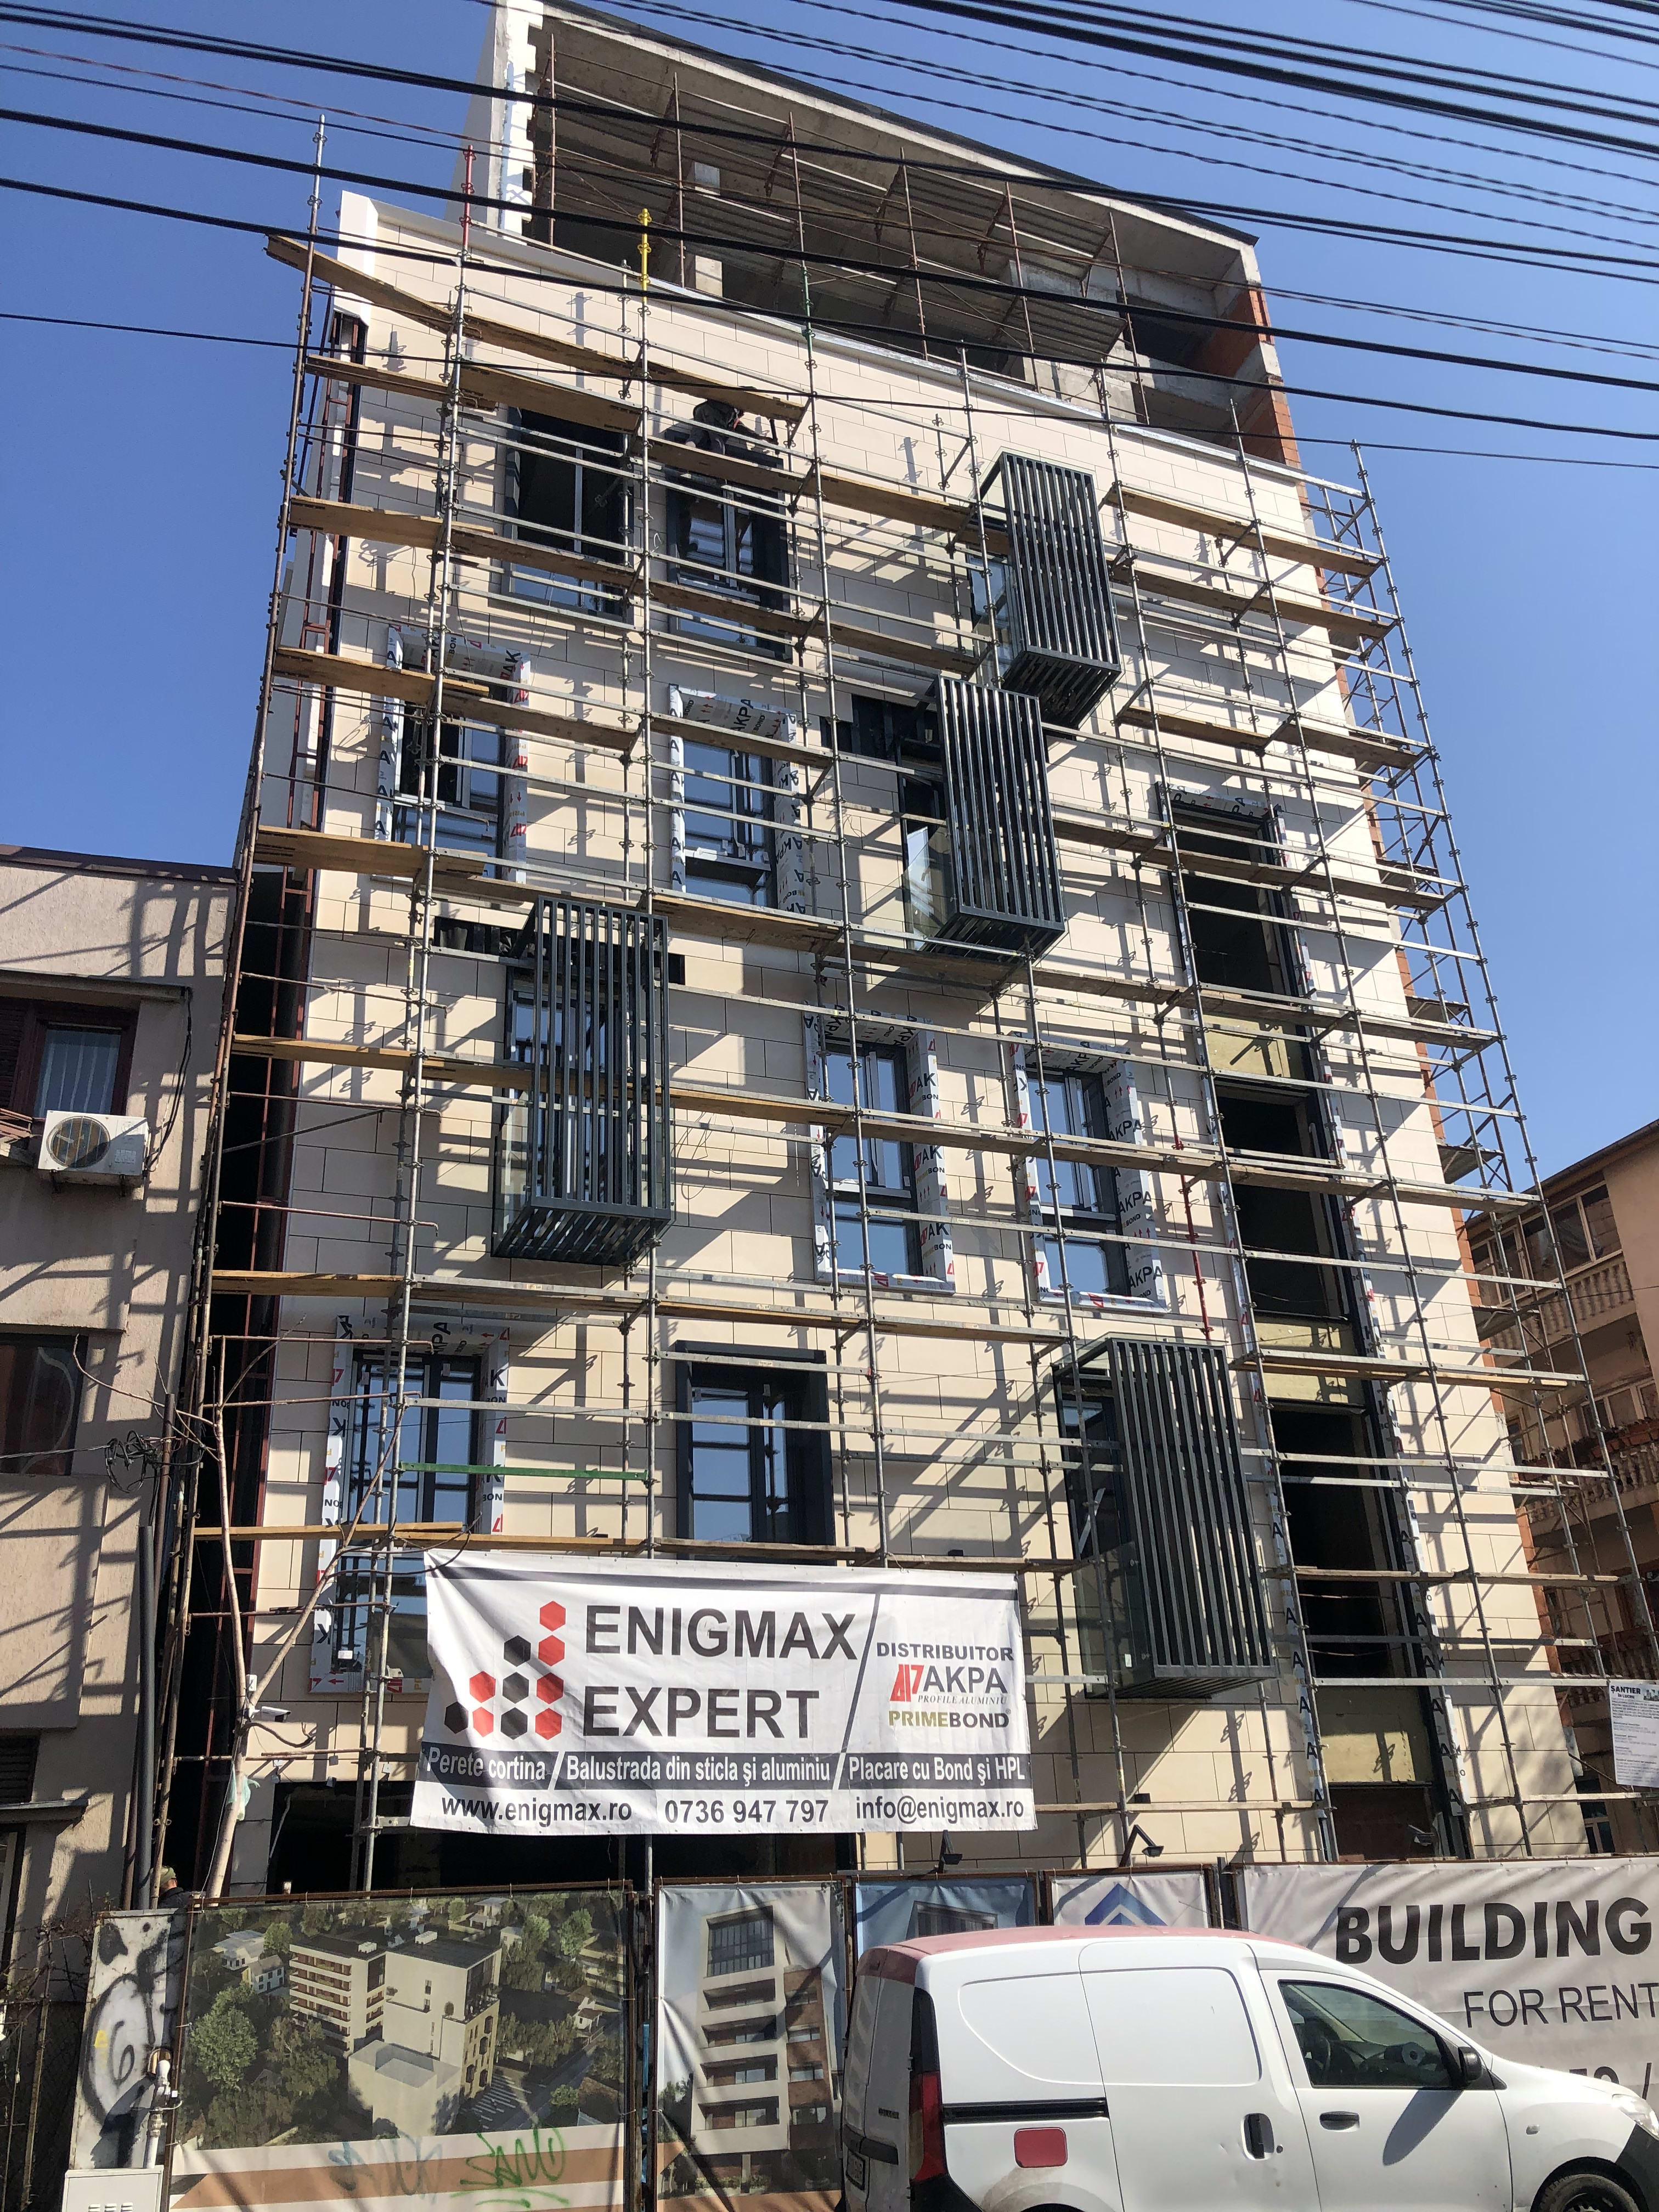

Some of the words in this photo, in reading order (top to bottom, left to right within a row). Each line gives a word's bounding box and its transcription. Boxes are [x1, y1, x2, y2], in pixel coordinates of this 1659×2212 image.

[585, 1605, 858, 1660] ENIGMAX
[877, 1642, 1014, 1661] DISTRIBUITOR
[923, 1665, 1008, 1694] AKPA
[583, 1685, 820, 1739] EXPERT
[917, 1695, 958, 1704] PROFILE
[960, 1696, 1007, 1705] ALUMINIU
[426, 1746, 484, 1777] Perete
[488, 1754, 545, 1780] cortina
[566, 1754, 661, 1781] Balustrada
[665, 1756, 691, 1781] din
[695, 1756, 738, 1781] sticla
[761, 1756, 831, 1781] aluminiu
[849, 1756, 909, 1781] Placare
[912, 1762, 930, 1781] cu
[934, 1756, 973, 1781] Bond
[995, 1756, 1026, 1780] HPL
[442, 1797, 633, 1828] www.enigmax.ro
[664, 1799, 725, 1824] 0736
[732, 1799, 777, 1823] 947
[785, 1799, 829, 1823] 797
[856, 1795, 1024, 1825] info@enigmax.ro
[1335, 1897, 1652, 1965] BUILDING
[1463, 1989, 1549, 2029] FOR
[1558, 1982, 1659, 2024] RENT
